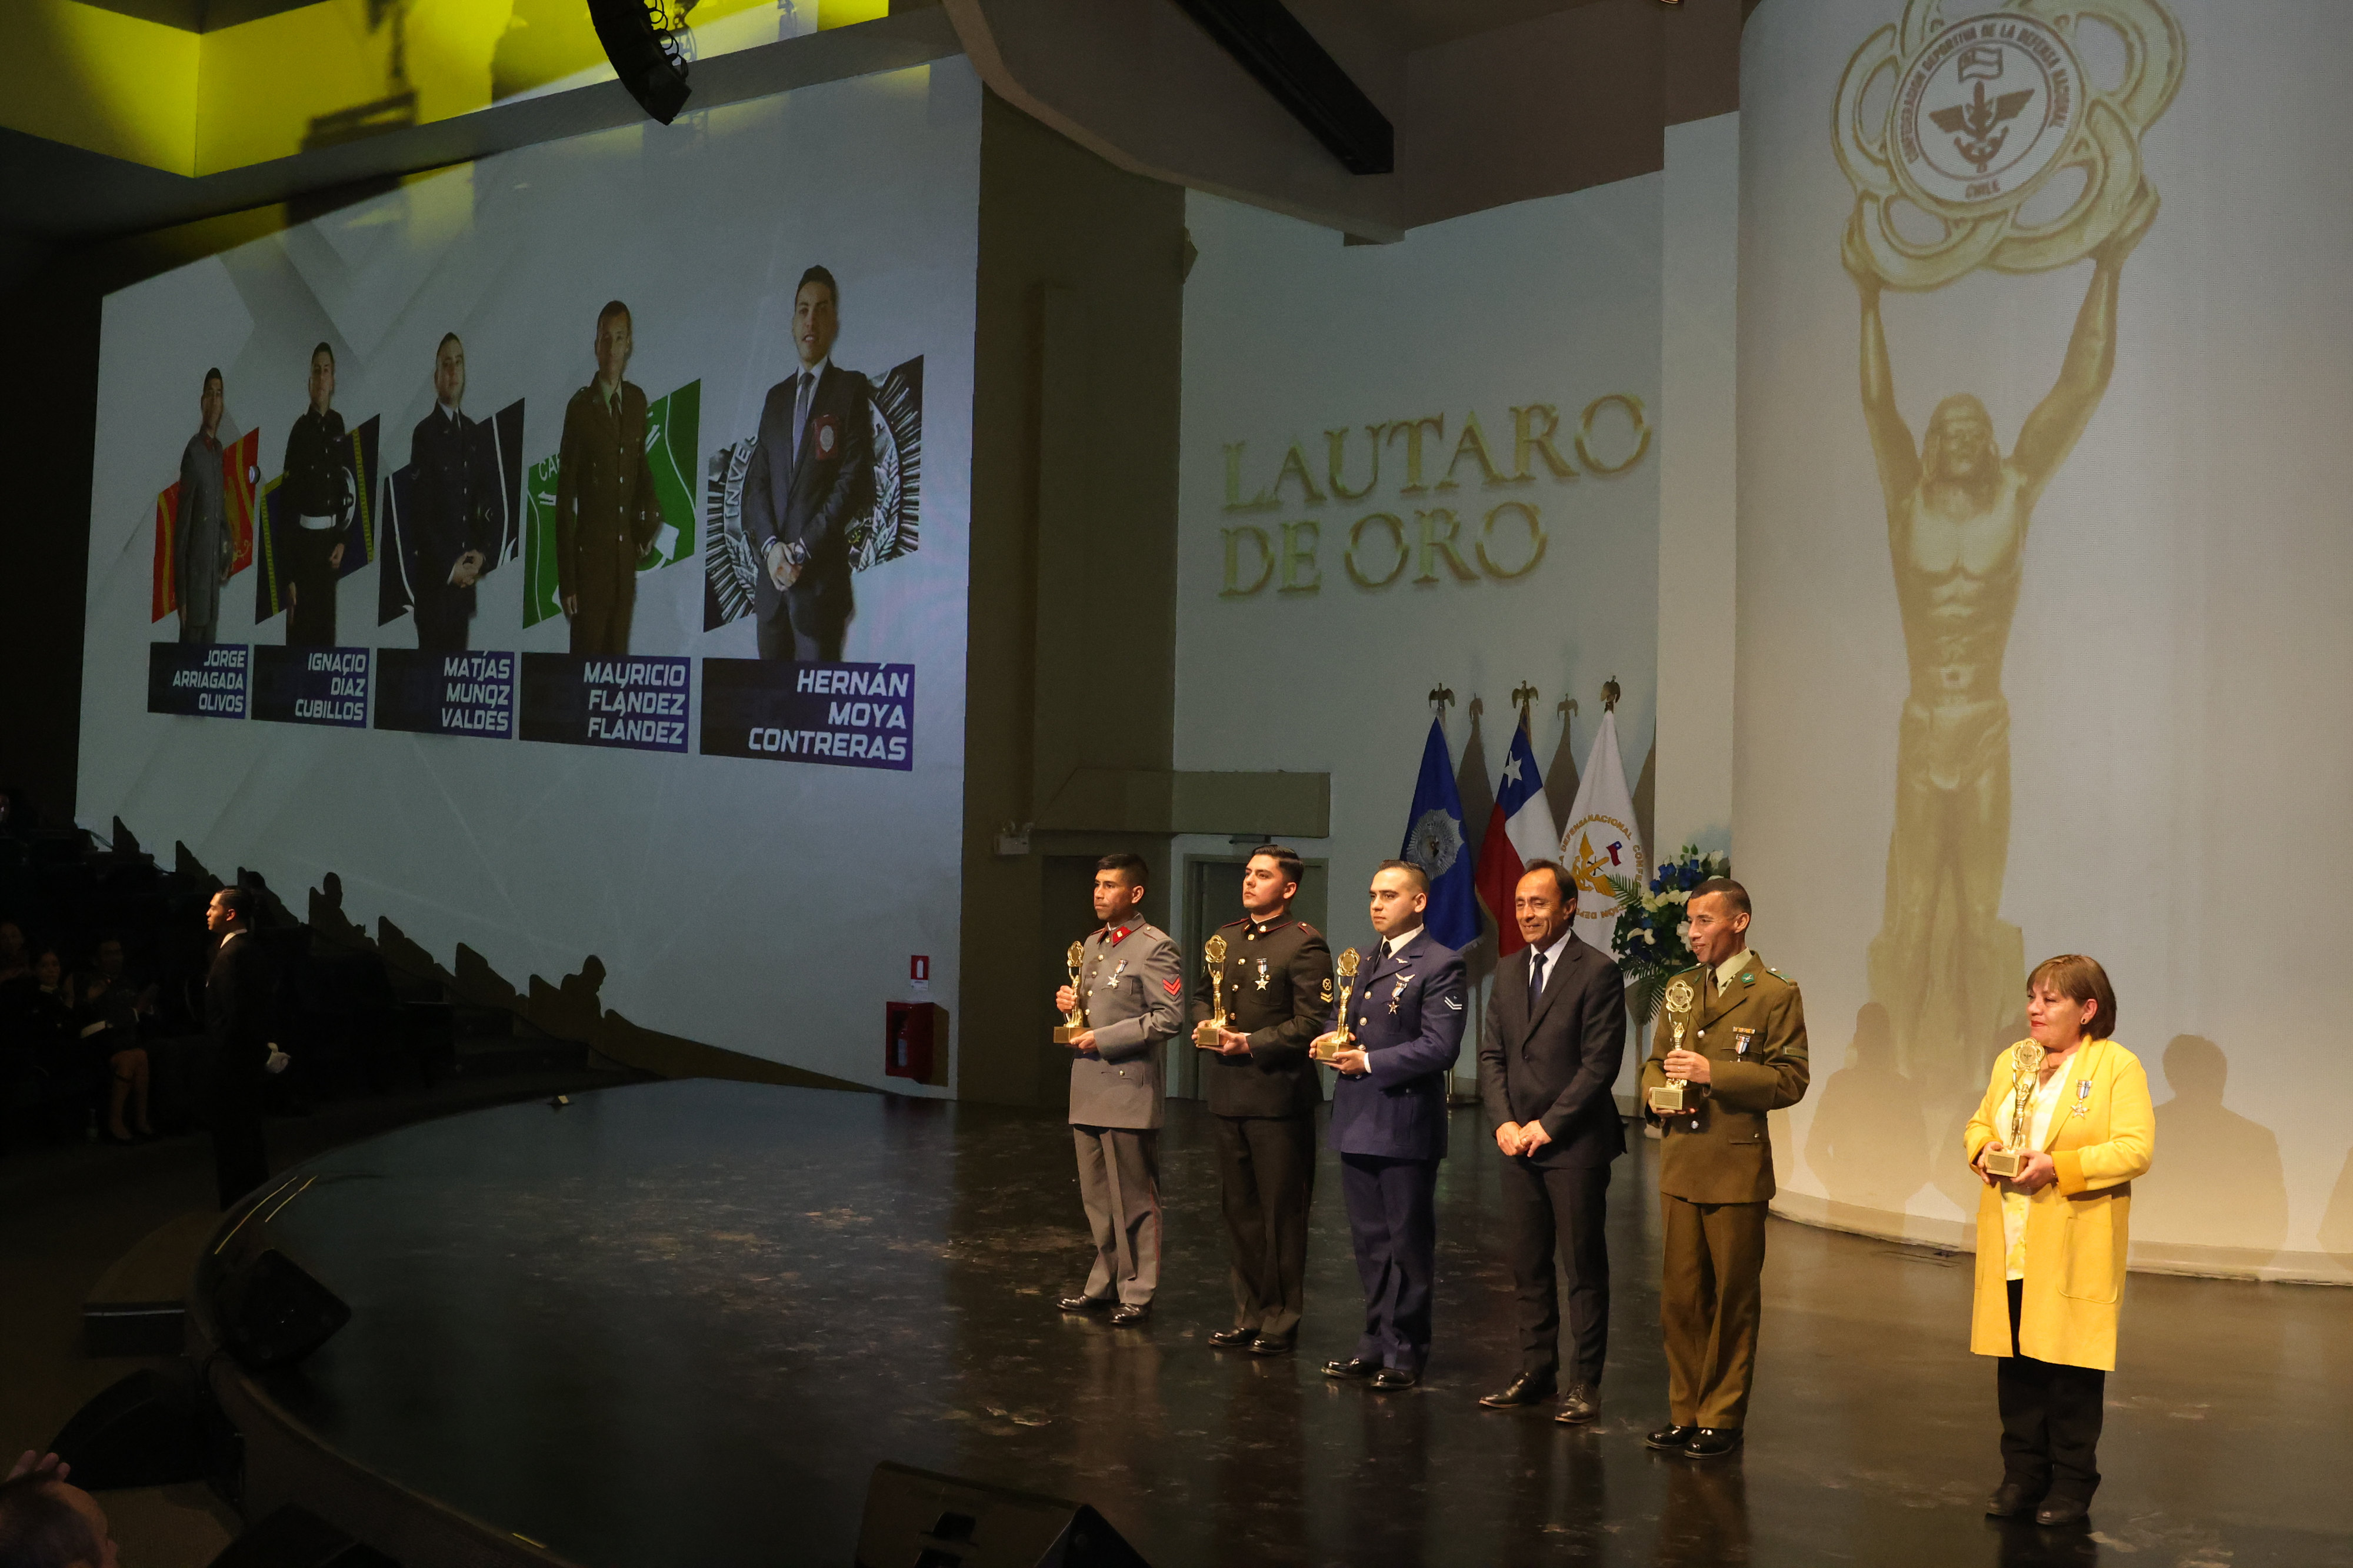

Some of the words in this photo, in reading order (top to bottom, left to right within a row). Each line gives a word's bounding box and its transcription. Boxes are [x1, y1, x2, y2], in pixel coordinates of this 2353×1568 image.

[1221, 393, 1651, 512] LAUTARO
[1219, 520, 1323, 600] DE
[1345, 501, 1548, 590] ORO
[204, 649, 246, 668] JORGE
[308, 653, 366, 673] IGNACIO
[444, 650, 511, 679] MATÍAS
[172, 670, 244, 690] ARRIAGADA
[584, 662, 686, 687] MAURICIO
[796, 663, 909, 697] HERNÁN
[198, 693, 244, 712] OLIVOS
[295, 699, 364, 721] CUBILLOS
[828, 702, 906, 729] MOYA
[748, 727, 907, 761] CONTRERAS
[1588, 814, 1633, 840] NACIONAL
